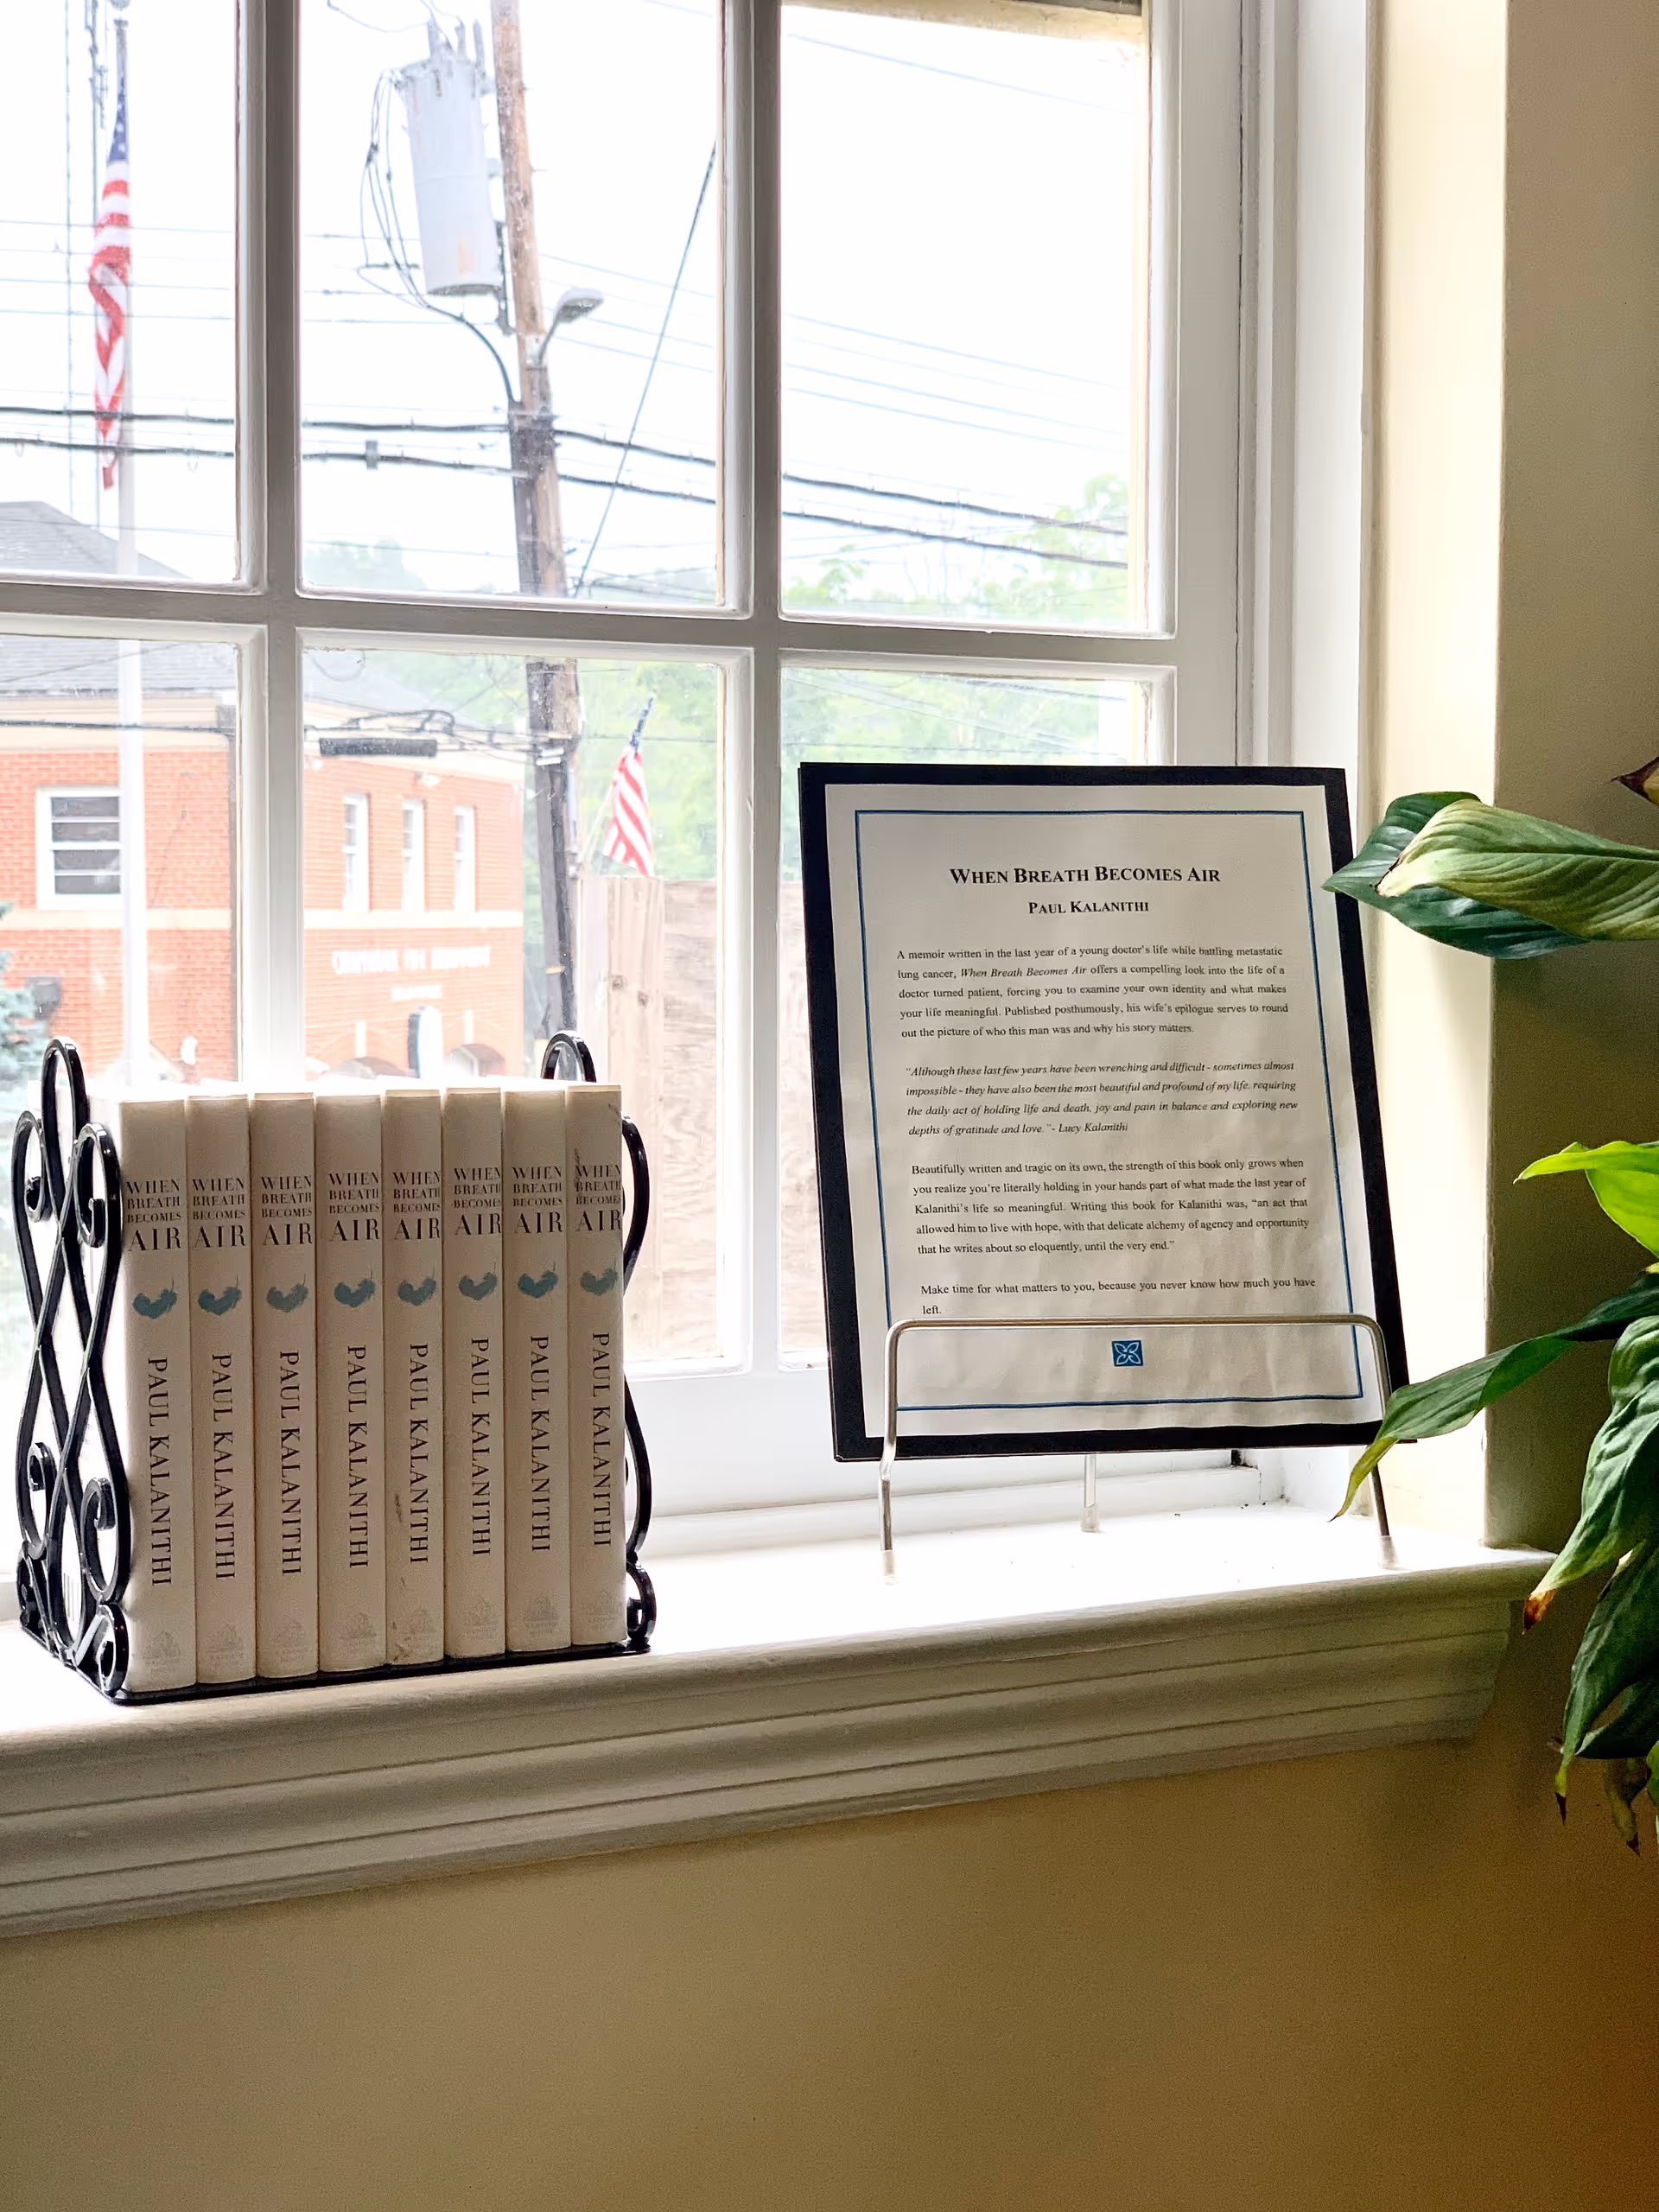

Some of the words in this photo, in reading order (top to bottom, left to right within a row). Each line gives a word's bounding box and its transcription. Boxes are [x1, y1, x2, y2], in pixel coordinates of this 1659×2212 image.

[949, 868, 1008, 884] WHEN
[1013, 868, 1090, 883] BREATH
[1093, 866, 1183, 881] BECOMES
[1186, 867, 1221, 882] AIR
[1028, 901, 1066, 914] PAUL
[1070, 900, 1149, 912] KALANITHI
[896, 950, 906, 959] A
[908, 950, 945, 959] memoir
[947, 949, 982, 958] written
[984, 949, 994, 958] in
[996, 948, 1012, 958] the
[1014, 948, 1031, 957] last
[1033, 950, 1055, 959] year
[1057, 946, 1070, 956] of
[1078, 947, 1109, 957] young
[1153, 944, 1168, 954] life
[1171, 945, 1196, 955] while
[1198, 946, 1234, 958] battling
[1236, 946, 1282, 956] metastatic
[897, 969, 919, 981] lung
[922, 970, 957, 979] cancer,
[961, 968, 987, 977] When
[990, 967, 1023, 977] Breath
[1026, 967, 1068, 976] Becomes
[1071, 965, 1087, 975] Air
[1090, 963, 1118, 974] offers
[1129, 964, 1182, 976] compelling
[1185, 964, 1205, 975] look
[1208, 965, 1227, 975] into
[1229, 965, 1244, 975] the
[1247, 965, 1263, 975] life
[1266, 964, 1277, 974] of
[899, 988, 930, 998] doctor
[932, 988, 964, 997] turned
[967, 987, 1002, 999] patient,
[1007, 987, 1041, 998] forcing
[1044, 988, 1063, 997] you
[1079, 984, 1120, 994] examine
[1123, 985, 1146, 995] your
[1172, 983, 1206, 995] identity
[1210, 984, 1227, 995] and
[1230, 984, 1254, 994] what
[1257, 983, 1287, 993] makes
[899, 1010, 923, 1020] your
[925, 1007, 942, 1017] life
[944, 1007, 1001, 1019] meaningful.
[1004, 1005, 1052, 1015] Published
[1054, 1003, 1123, 1016] posthumously,
[1126, 1002, 1141, 1013] his
[1174, 1003, 1214, 1015] epilogue
[1262, 1002, 1288, 1013] round
[919, 1027, 935, 1037] the
[937, 1027, 970, 1039] picture
[972, 1026, 984, 1036] of
[985, 1027, 1007, 1036] who
[1008, 1026, 1027, 1035] this
[1073, 1023, 1090, 1033] and
[1091, 1023, 1113, 1035] why
[1116, 1022, 1130, 1033] his
[1132, 1024, 1156, 1033] story
[1158, 1024, 1194, 1033] matters.
[328, 1172, 378, 1185] WHEN
[393, 1172, 440, 1185] WHEN
[454, 1167, 500, 1180] WHEN
[512, 1166, 562, 1179] WHEN
[575, 1165, 620, 1178] WHEN
[125, 1179, 180, 1193] WHEN
[193, 1178, 244, 1191] WHEN
[261, 1175, 311, 1189] WHEN
[454, 1184, 500, 1194] BREATH
[513, 1182, 562, 1193] BREATH
[575, 1180, 620, 1192] BREATH
[193, 1194, 245, 1205] BREATH
[262, 1192, 311, 1203] BREATH
[329, 1189, 378, 1199] BREATH
[394, 1187, 440, 1198] BREATH
[576, 1196, 621, 1205] BECOMES
[128, 1197, 180, 1209] BREATH
[329, 1203, 379, 1214] BECOMES
[394, 1203, 440, 1212] BECOMES
[454, 1199, 501, 1208] BECOMES
[972, 1203, 988, 1213] life
[1008, 1201, 1066, 1213] meaningful.
[1070, 1201, 1108, 1212] Writing
[1110, 1200, 1128, 1211] this
[1132, 1200, 1156, 1210] book
[1160, 1199, 1174, 1210] for
[1178, 1199, 1222, 1209] Kalanithi
[1225, 1200, 1248, 1209] was,
[1289, 1198, 1308, 1207] that
[128, 1212, 181, 1223] BECOMES
[193, 1210, 245, 1220] BECOMES
[262, 1207, 312, 1217] BECOMES
[576, 1210, 620, 1231] AIR
[330, 1218, 379, 1241] AIR
[394, 1218, 440, 1239] AIR
[454, 1213, 501, 1235] AIR
[515, 1211, 563, 1233] AIR
[129, 1227, 181, 1251] AIR
[194, 1225, 245, 1248] AIR
[263, 1223, 313, 1245] AIR
[920, 1284, 949, 1294] Make
[952, 1283, 974, 1294] time
[976, 1283, 992, 1294] for
[995, 1283, 1019, 1293] what
[1021, 1284, 1058, 1293] matters
[1060, 1283, 1071, 1292] to
[1072, 1284, 1096, 1294] you,
[1097, 1281, 1136, 1290] because
[1139, 1282, 1157, 1292] you
[1189, 1280, 1217, 1288] know
[1218, 1278, 1240, 1288] how
[1243, 1277, 1270, 1288] much
[1272, 1280, 1291, 1289] you
[1294, 1277, 1315, 1287] have
[922, 1305, 942, 1315] left.
[472, 1338, 489, 1403] PAUL
[531, 1336, 550, 1401] PAUL
[593, 1332, 610, 1397] PAUL
[280, 1351, 300, 1419] PAUL
[347, 1345, 366, 1412] PAUL
[410, 1344, 428, 1409] PAUL
[148, 1357, 169, 1427] PAUL
[213, 1354, 232, 1422] PAUL
[472, 1412, 490, 1555] KALANITHI
[531, 1408, 550, 1552] KALANITHI
[593, 1405, 611, 1547] KALANITHI
[349, 1421, 368, 1568] KALANITHI
[410, 1419, 429, 1564] KALANITHI
[213, 1431, 235, 1580] KALANITHI
[281, 1427, 301, 1576] KALANITHI
[149, 1435, 171, 1586] KALANITHI
